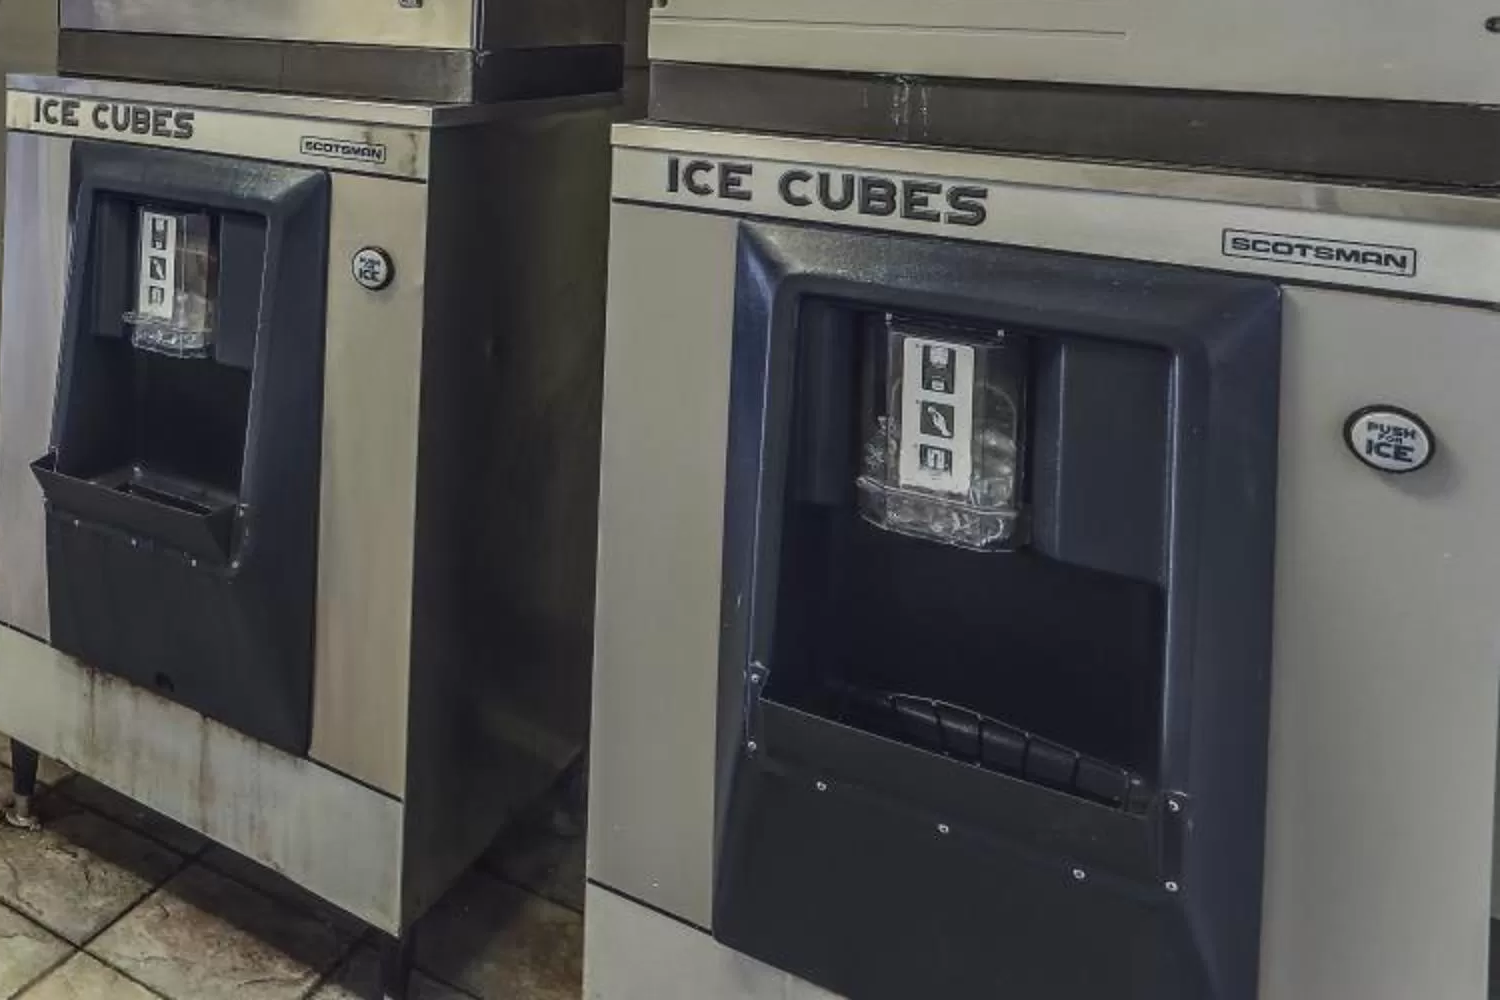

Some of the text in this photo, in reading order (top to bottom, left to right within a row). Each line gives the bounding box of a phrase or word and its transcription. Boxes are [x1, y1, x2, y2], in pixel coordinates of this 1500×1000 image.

[34, 97, 195, 140] ICE CUBES
[305, 141, 382, 160] SCOTSMAN
[666, 156, 989, 227] ICE CUBES
[1231, 237, 1408, 269] SCOTSMAN
[1367, 421, 1417, 440] PUSH
[1365, 439, 1415, 463] ICE
